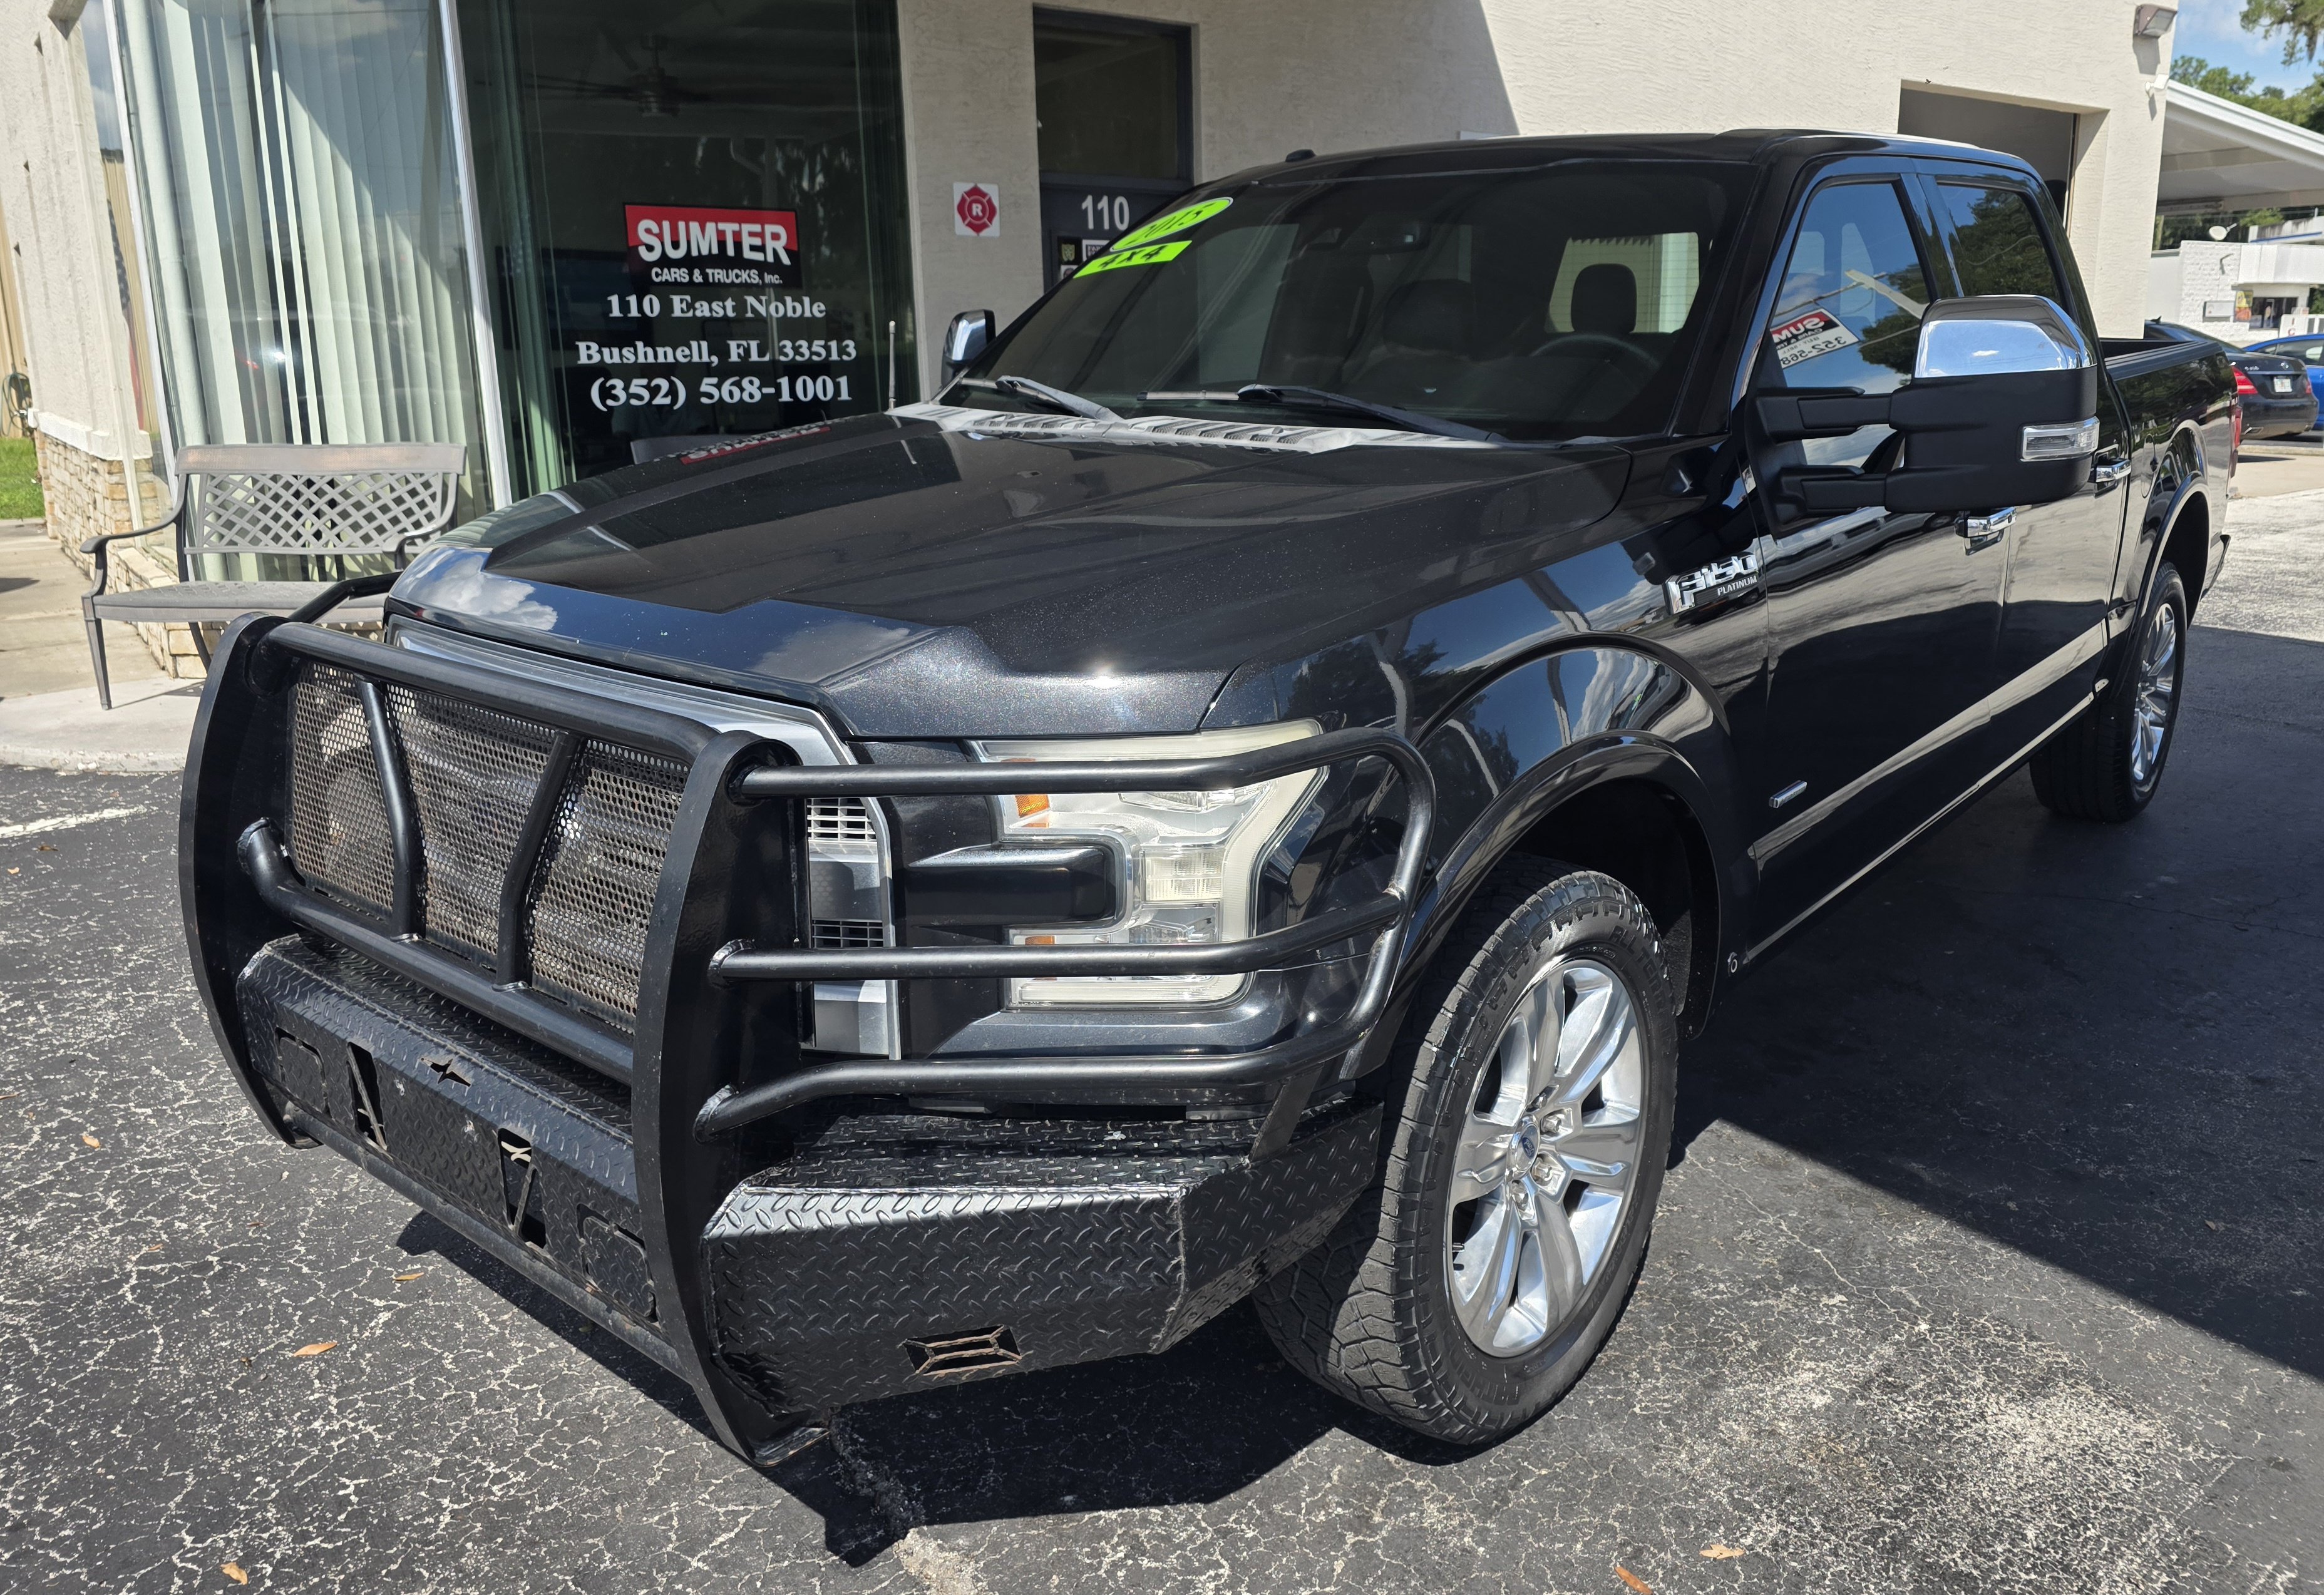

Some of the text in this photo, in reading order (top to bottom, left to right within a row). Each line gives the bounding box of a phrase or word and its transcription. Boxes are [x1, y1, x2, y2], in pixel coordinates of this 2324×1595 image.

[972, 203, 983, 217] R
[1081, 195, 1129, 230] 110
[637, 219, 791, 265] SUMTER
[651, 267, 689, 282] CARS
[693, 269, 704, 282] &
[706, 269, 762, 285] TRUCKS,
[607, 294, 826, 318] 110 East Noble
[575, 339, 856, 367] Bushnell, FL 33513
[590, 376, 852, 411] (352) 568-1001
[1717, 576, 1757, 596] PLATINUM
